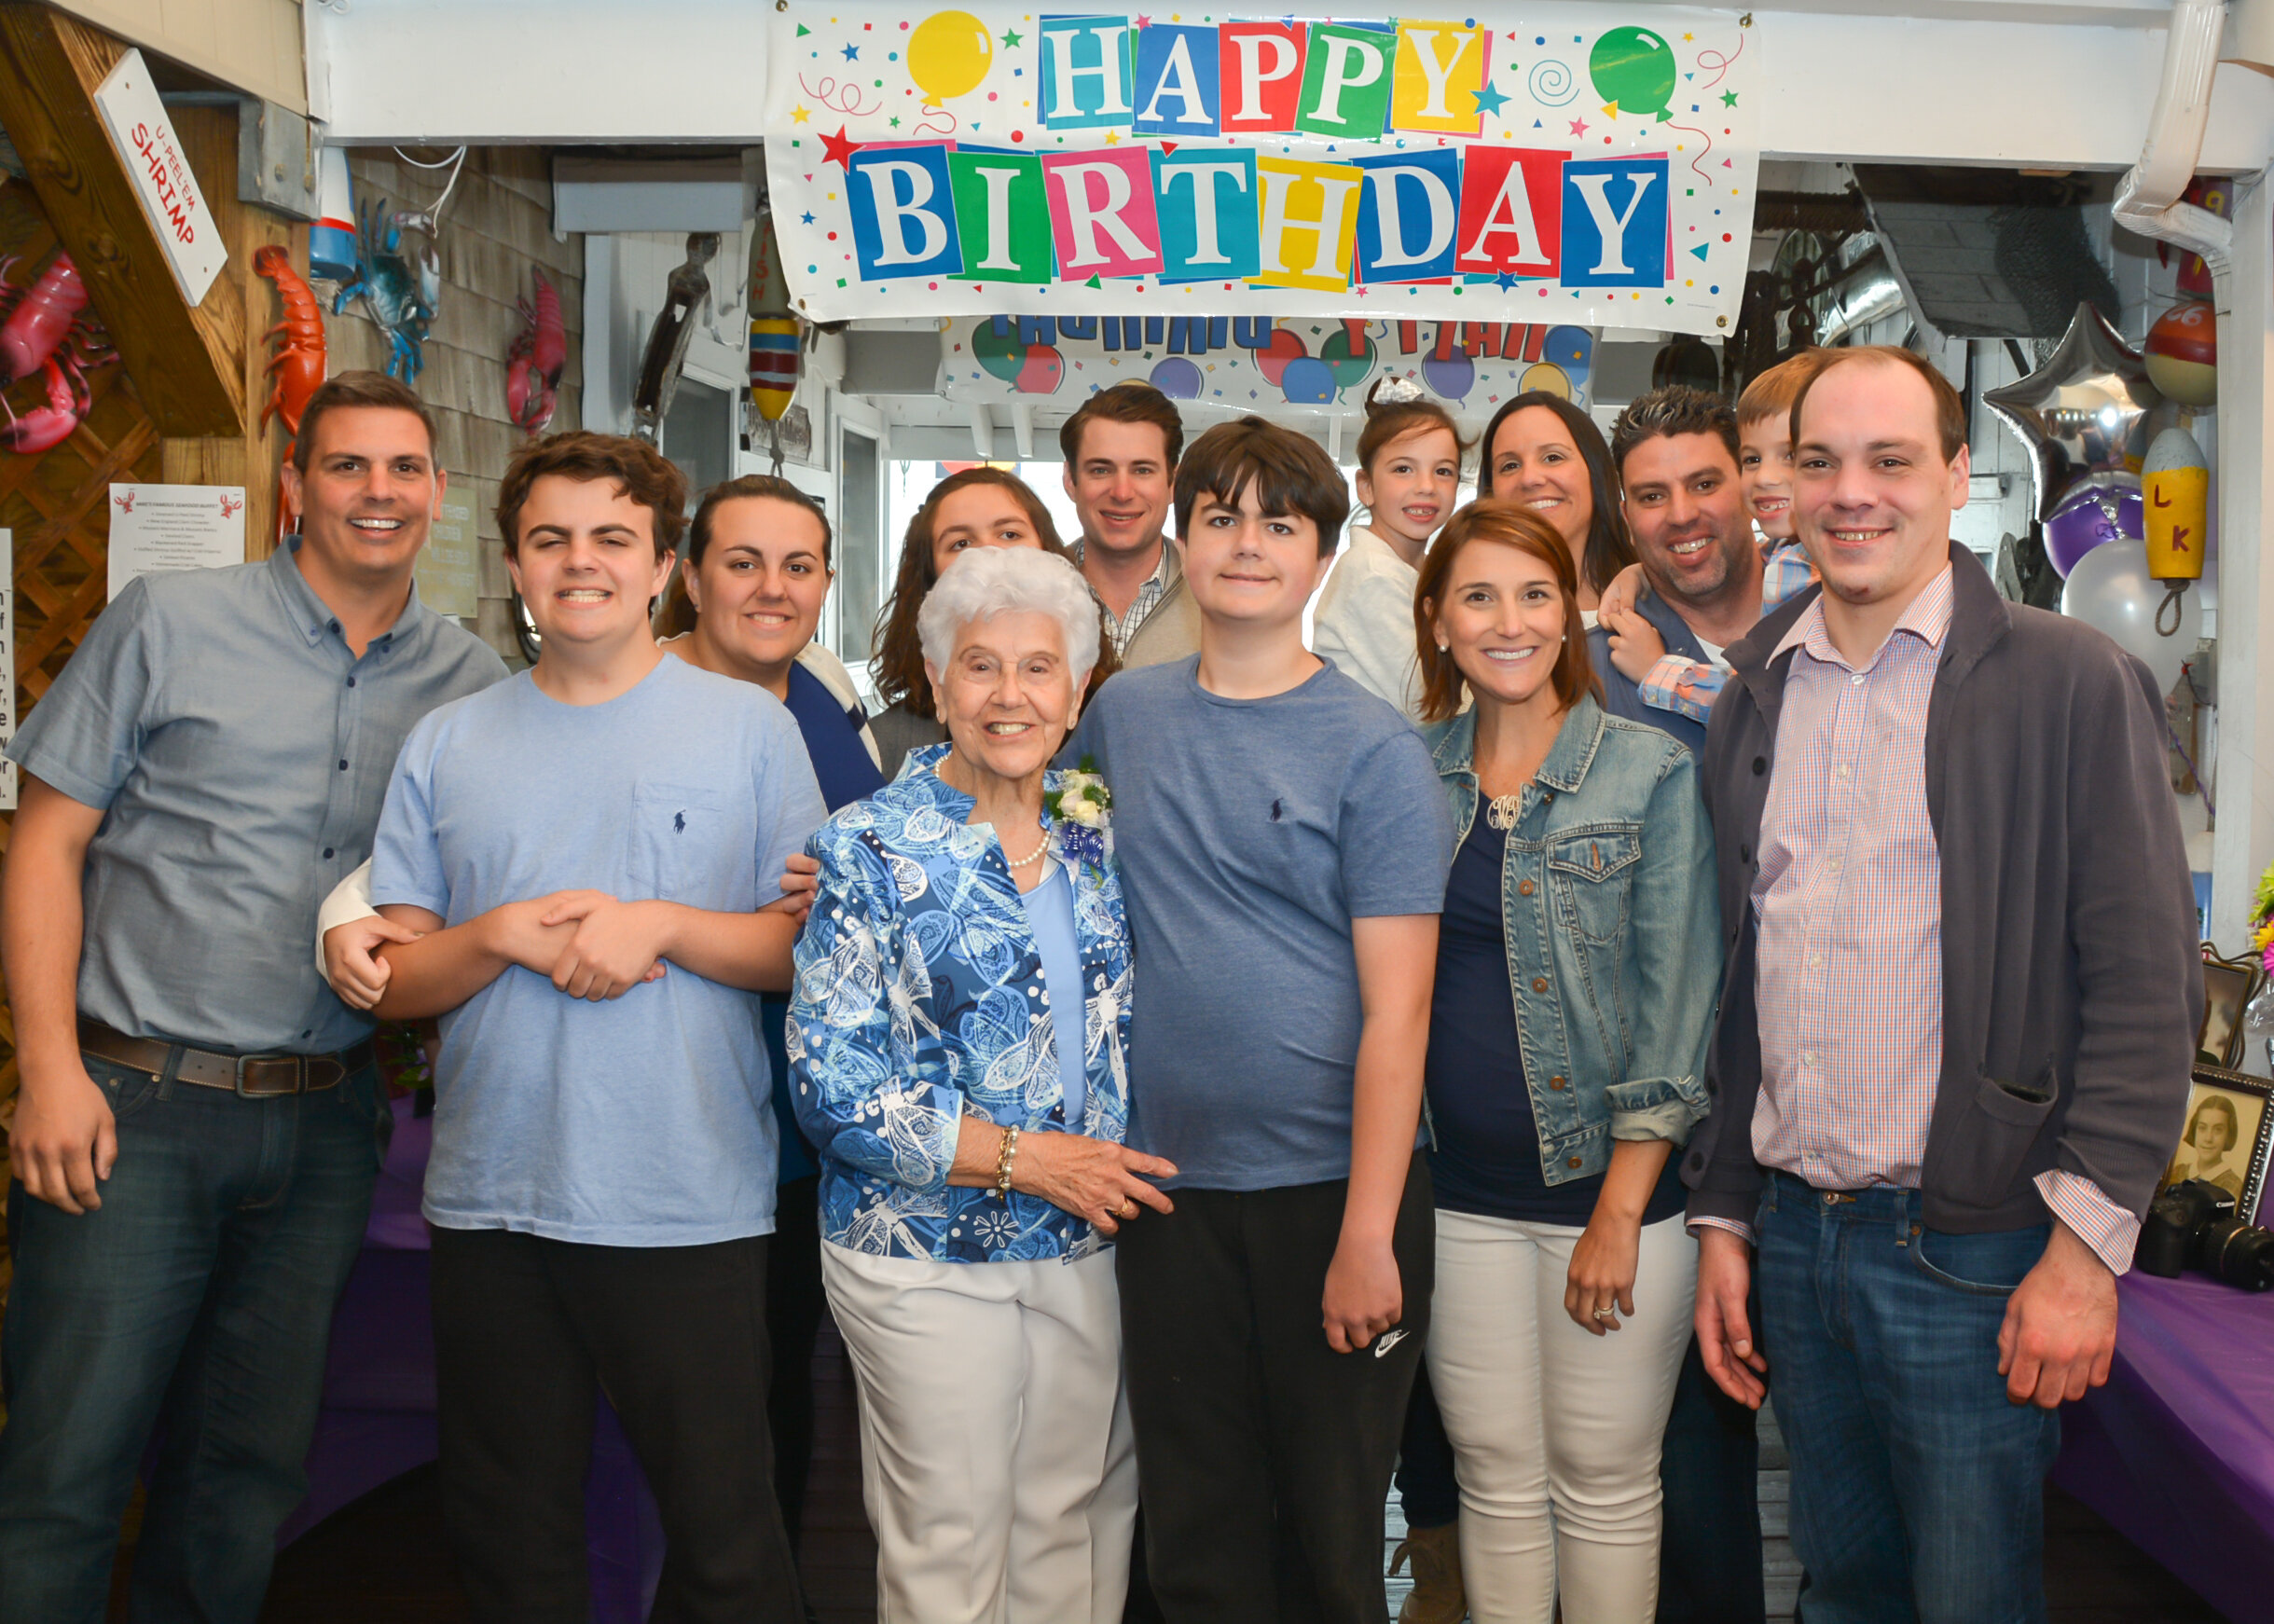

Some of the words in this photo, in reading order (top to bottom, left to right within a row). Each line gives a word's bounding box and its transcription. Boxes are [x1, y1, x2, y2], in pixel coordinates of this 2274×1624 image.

[1041, 25, 1476, 125] HAPPY
[131, 122, 194, 243] SHRIMP
[857, 159, 1658, 280] BIRTHDAY
